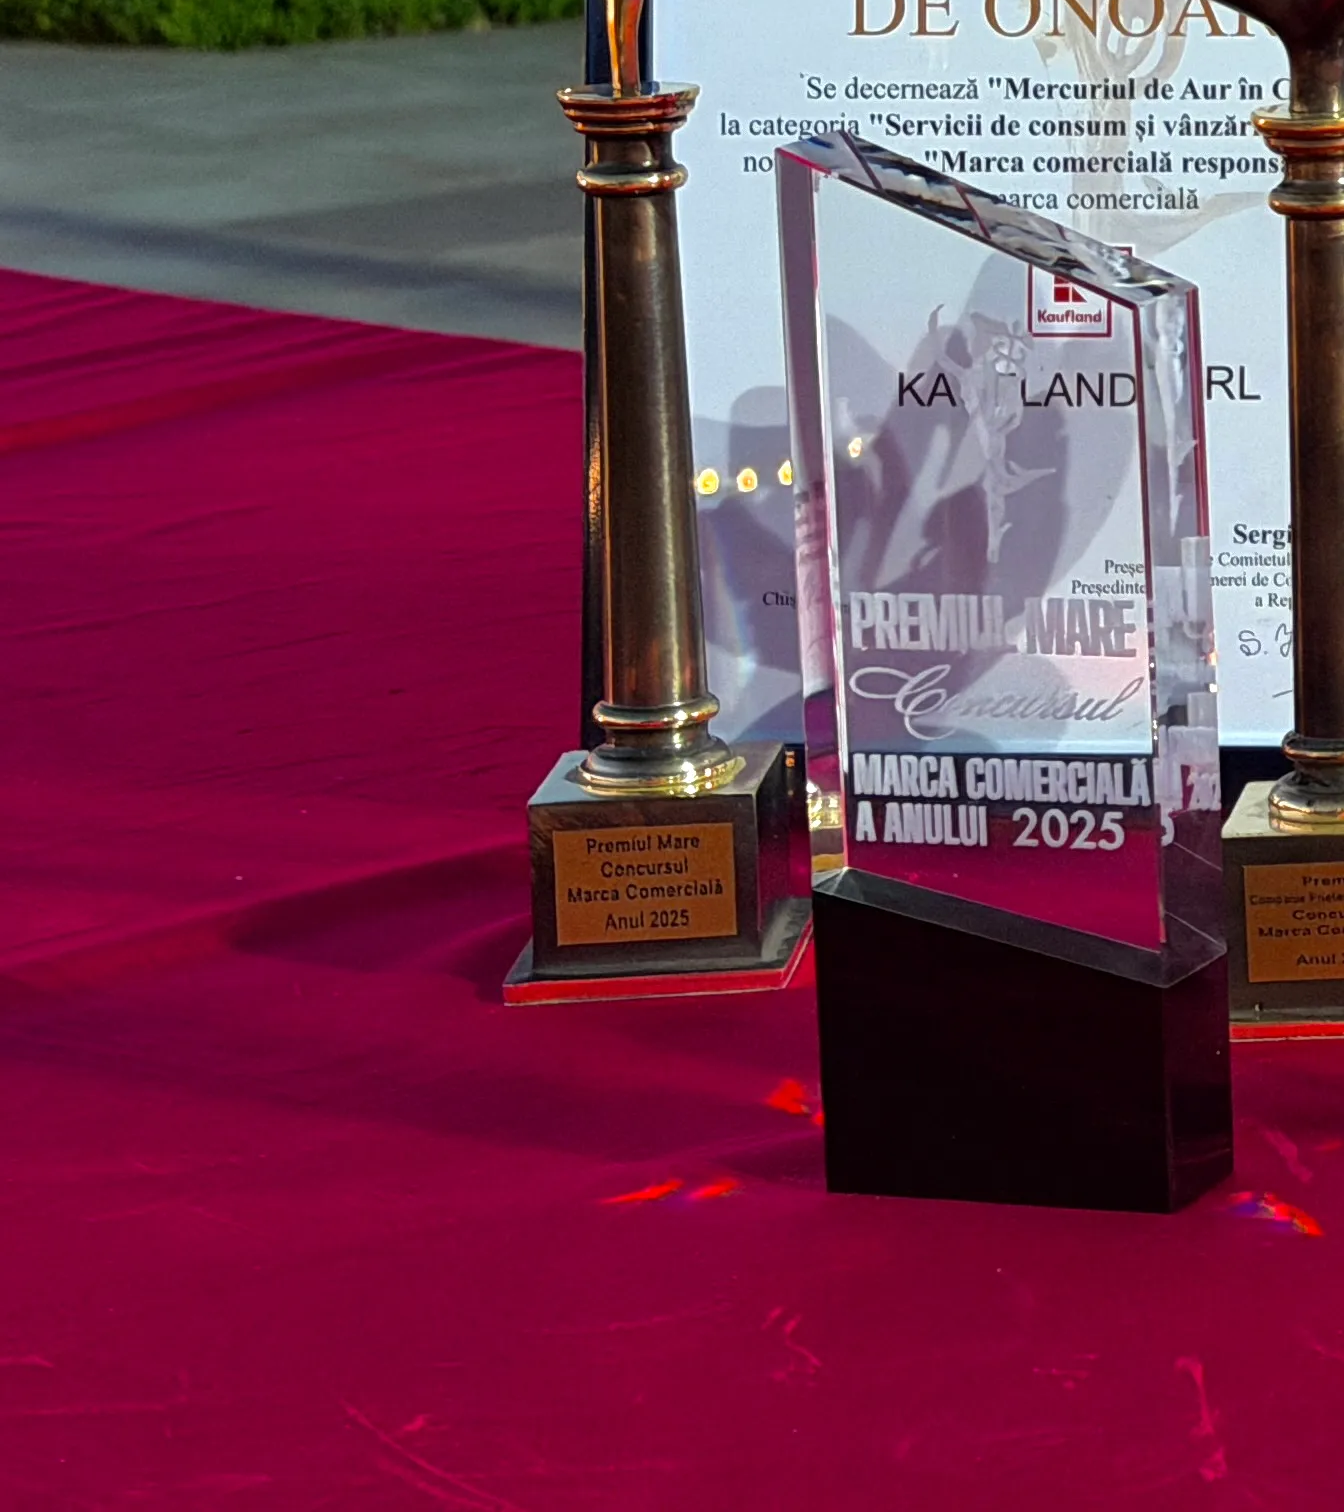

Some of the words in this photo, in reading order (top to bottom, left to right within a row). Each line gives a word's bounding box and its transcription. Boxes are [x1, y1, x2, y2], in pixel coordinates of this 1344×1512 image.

[806, 76, 837, 100] Se
[845, 75, 979, 101] decernează
[988, 76, 1137, 101] "Mercuriul
[1144, 76, 1175, 101] de
[1180, 77, 1231, 101] Aur
[1238, 76, 1263, 101] în
[720, 112, 740, 137] la
[748, 114, 860, 140] categoria
[870, 113, 983, 137] "Servicii
[990, 113, 1021, 137] de
[1028, 117, 1127, 138] consum
[1163, 113, 1262, 138] vânzăr
[924, 149, 1025, 174] "Marca
[1033, 150, 1174, 174] comercială
[1066, 187, 1200, 210] comercială
[1037, 309, 1102, 324] Kaufland
[898, 372, 1138, 407] KALAND
[849, 592, 1020, 654] PREMIUL
[1025, 597, 1137, 658] MARE
[849, 664, 1145, 741] Concursul
[853, 752, 959, 799] MARCA
[965, 758, 1152, 807] COMERCIALĂ
[855, 800, 877, 842] A
[883, 801, 989, 847] ANULUI
[1012, 806, 1126, 851] 2025
[586, 834, 652, 856] Premiul
[657, 833, 701, 851] Mare
[600, 857, 689, 879] Concursul
[567, 886, 620, 904] Marca
[625, 878, 724, 900] Comercială
[604, 911, 645, 931] Anul
[650, 908, 690, 929] 2025
[1257, 925, 1313, 939] Marca
[1295, 951, 1337, 967] Anul
